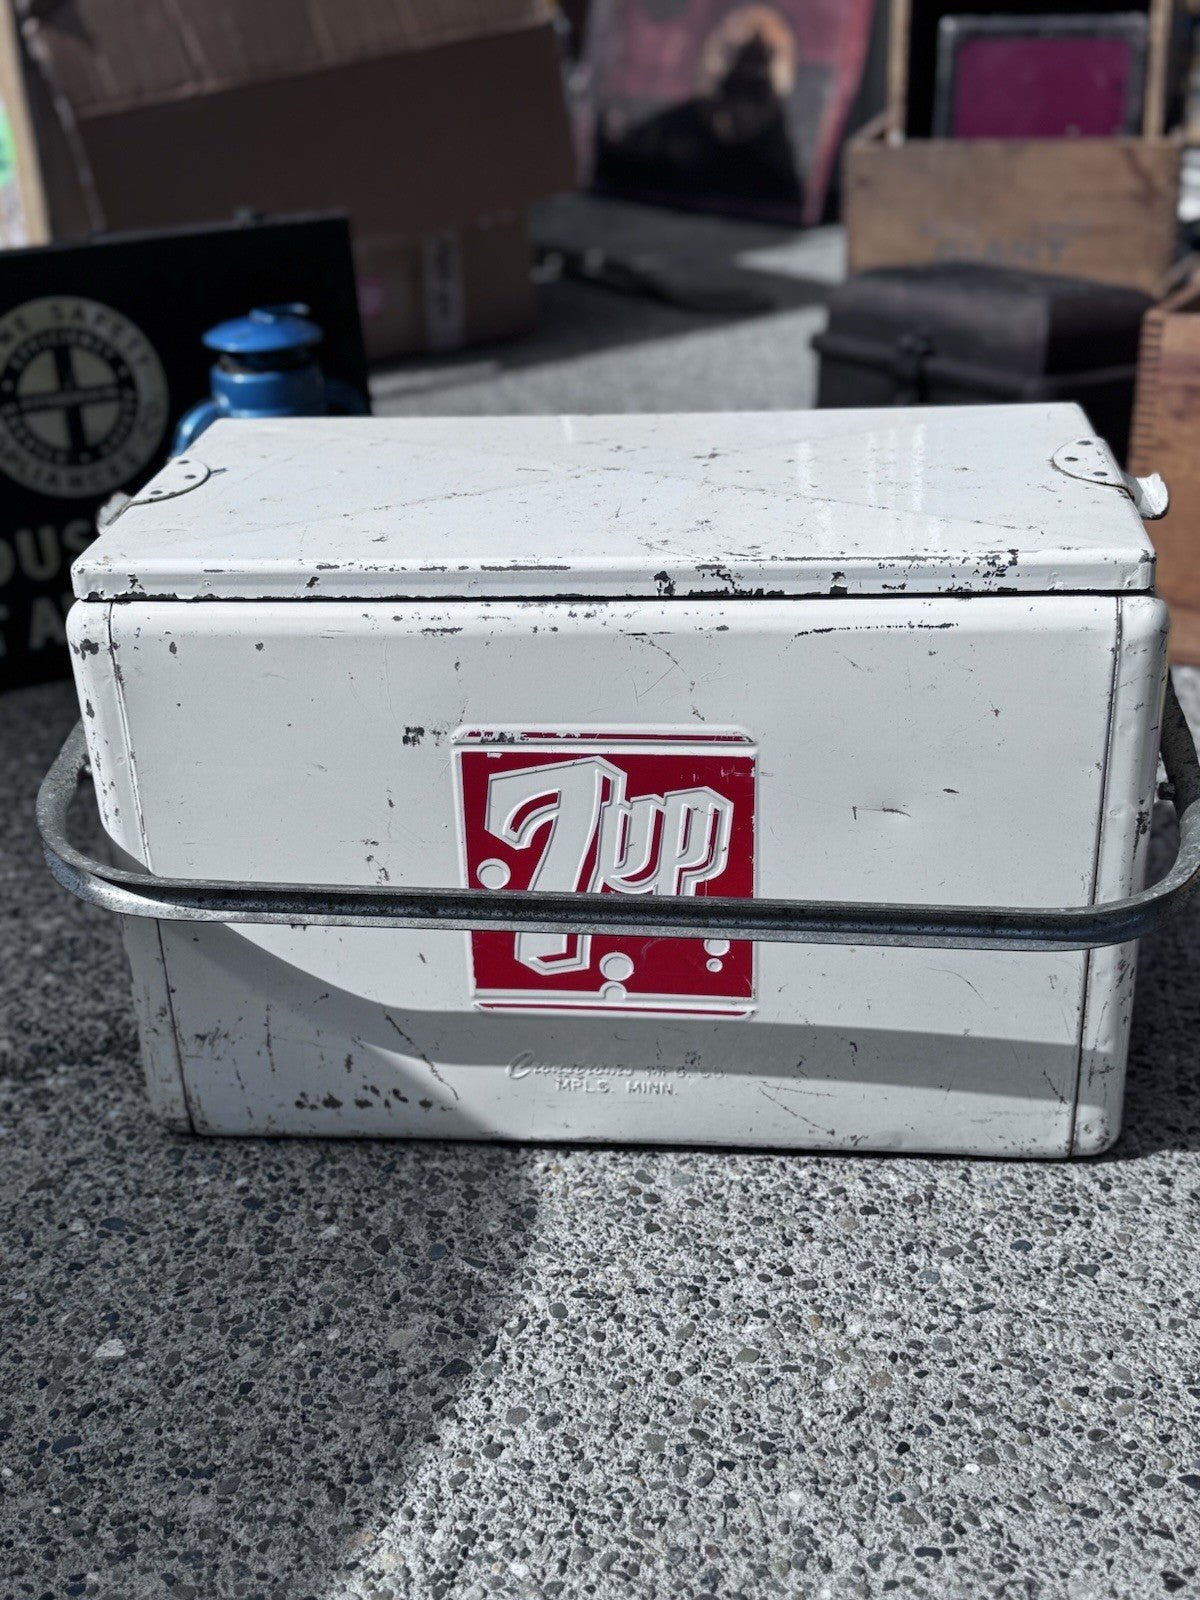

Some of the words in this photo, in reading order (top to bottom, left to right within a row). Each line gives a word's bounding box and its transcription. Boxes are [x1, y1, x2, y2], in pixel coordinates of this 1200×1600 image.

[50, 303, 151, 366] SAFETY
[555, 1077, 614, 1094] MPLS.
[625, 1080, 678, 1096] MINN.
